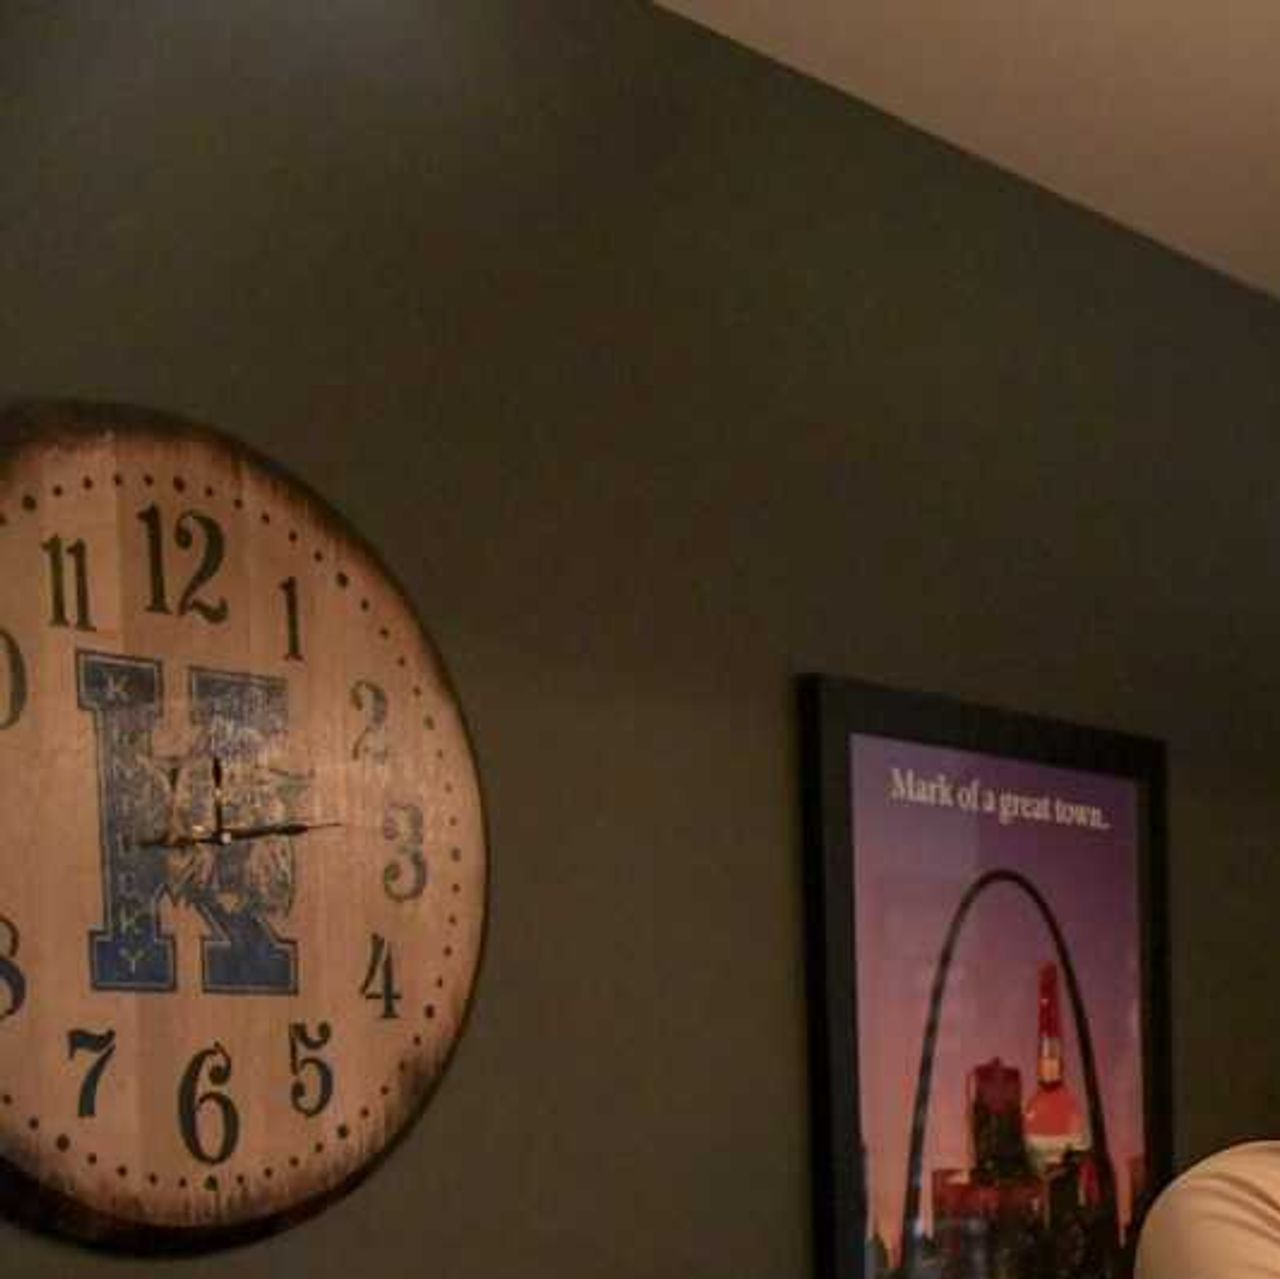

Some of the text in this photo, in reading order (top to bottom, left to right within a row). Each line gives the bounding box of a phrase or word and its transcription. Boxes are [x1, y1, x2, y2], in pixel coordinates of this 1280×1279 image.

[41, 533, 98, 632] 11
[137, 502, 230, 625] 12
[278, 575, 304, 662] 1
[350, 678, 388, 766] 2
[890, 767, 1112, 831] Mark of a great town.
[382, 803, 427, 902] 3
[360, 932, 402, 1019] 4
[67, 1028, 116, 1119] 7
[177, 1040, 240, 1166] 6
[288, 1021, 334, 1118] 5
